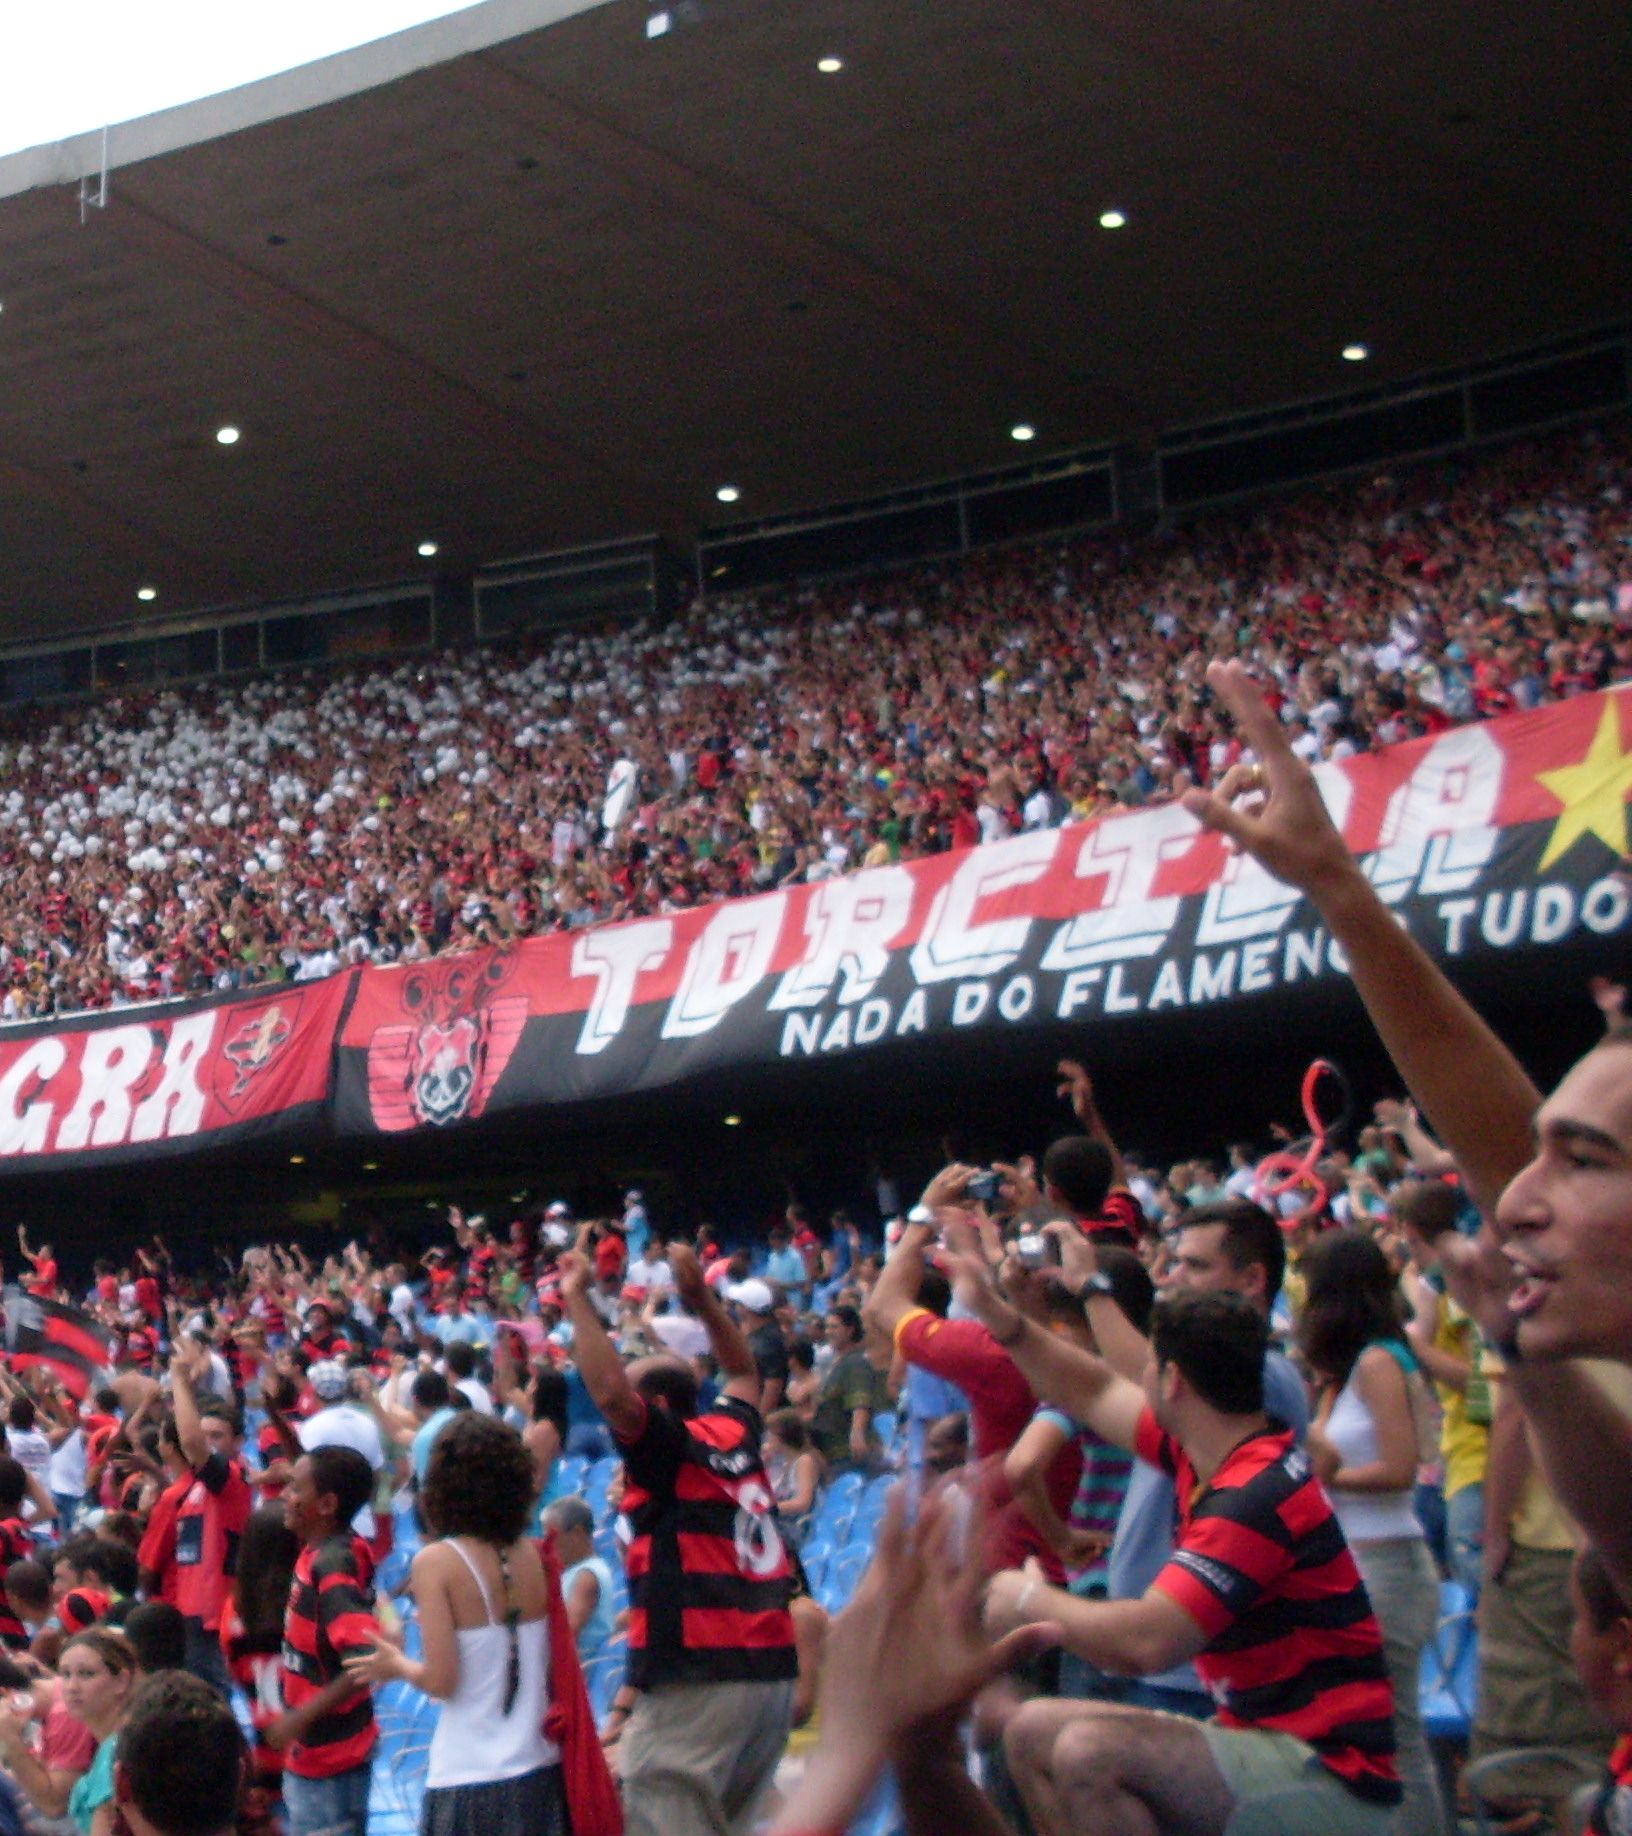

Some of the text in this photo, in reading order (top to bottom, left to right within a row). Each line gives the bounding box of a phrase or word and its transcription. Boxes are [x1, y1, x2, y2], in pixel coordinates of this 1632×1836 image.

[780, 998, 926, 1057] NADA
[952, 975, 1034, 1026] DO
[1437, 877, 1628, 955] TUDO
